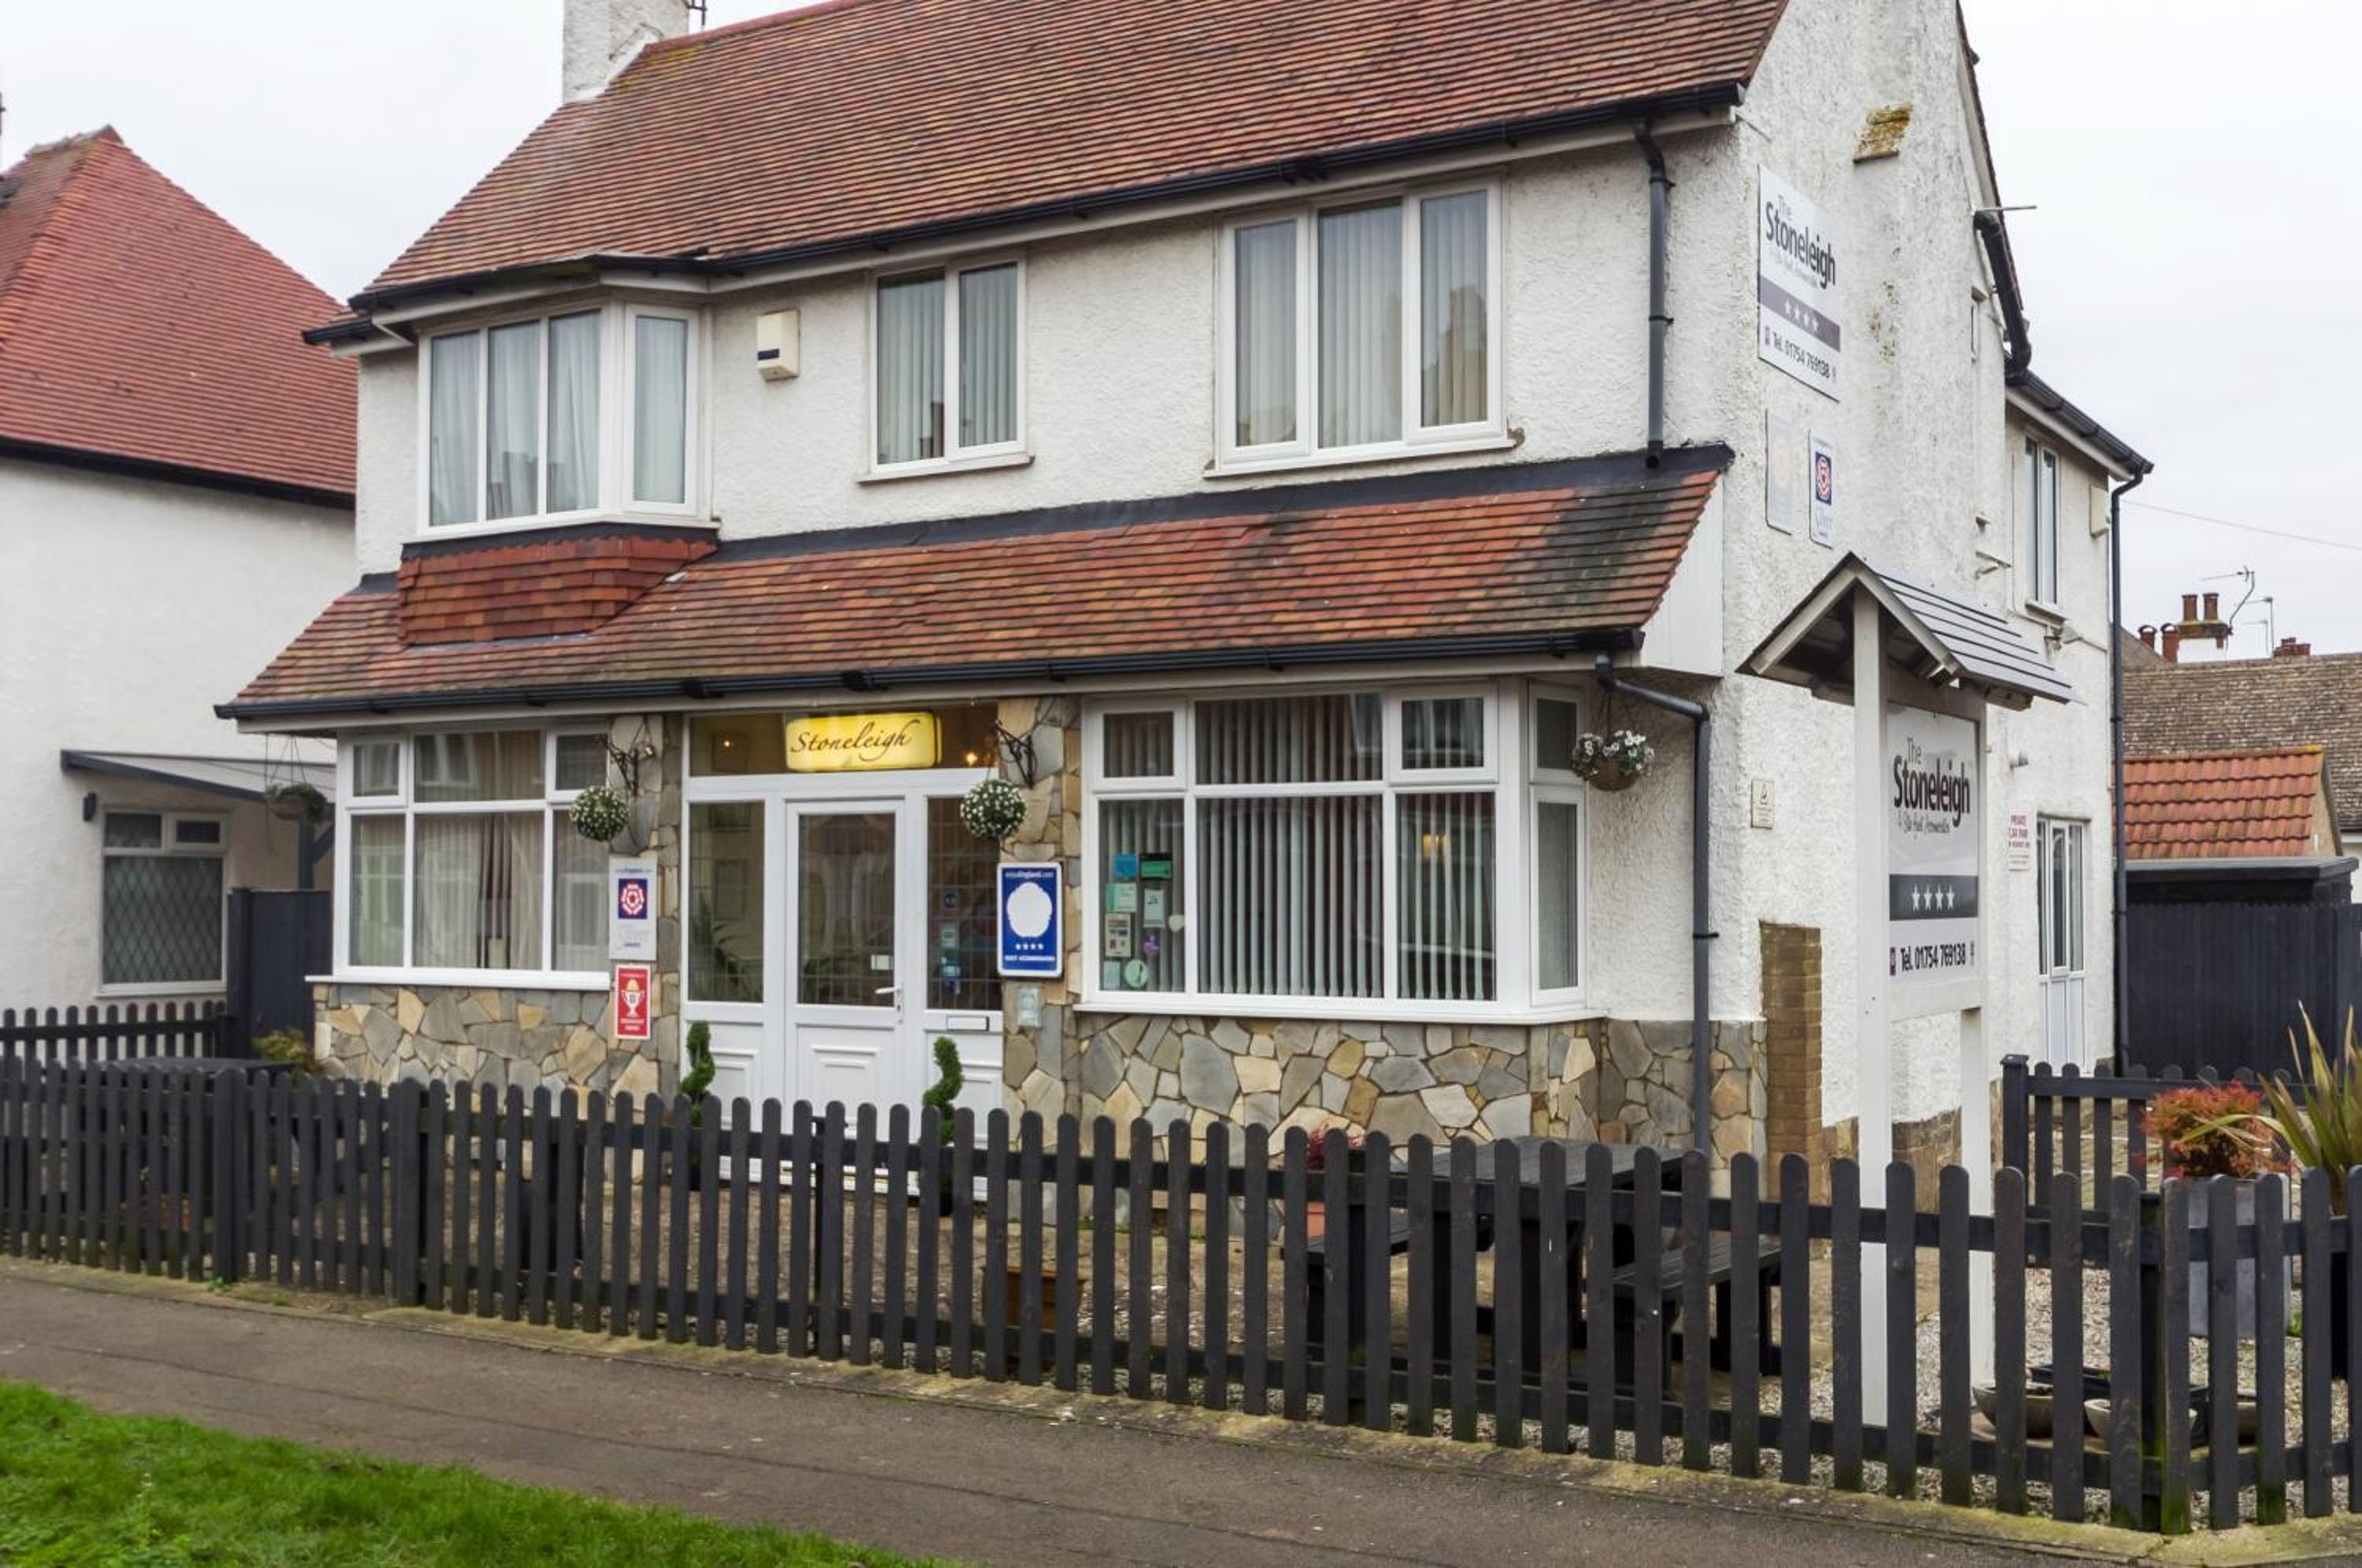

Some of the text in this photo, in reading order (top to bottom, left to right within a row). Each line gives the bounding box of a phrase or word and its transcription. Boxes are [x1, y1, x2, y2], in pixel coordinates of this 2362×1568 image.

[1766, 201, 1835, 290] Stoneleigh
[790, 718, 920, 763] Stoneleigh
[1907, 737, 1921, 764] The
[1894, 755, 1970, 827] Stoneleigh
[1915, 945, 1938, 969] 01754
[1939, 942, 1965, 967] 769138
